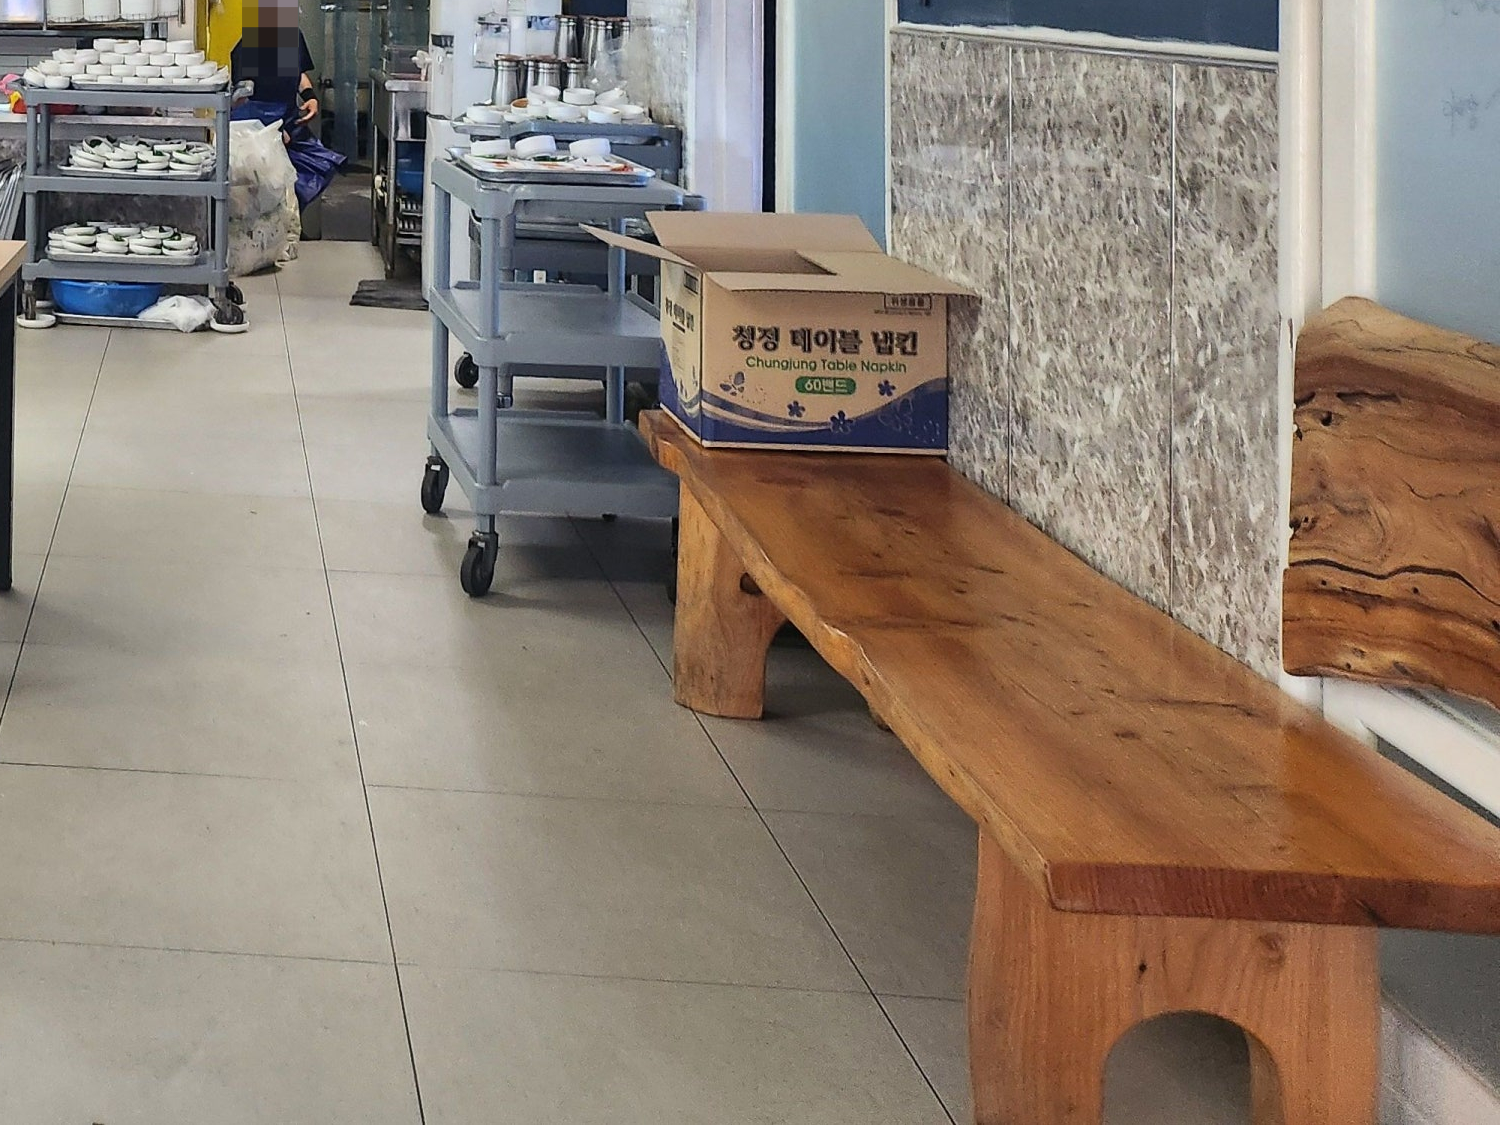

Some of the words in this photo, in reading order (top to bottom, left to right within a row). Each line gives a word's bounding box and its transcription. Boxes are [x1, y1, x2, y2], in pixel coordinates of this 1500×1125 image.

[733, 325, 780, 352] 청정
[789, 327, 862, 355] 테이블
[871, 329, 919, 356] 냅킨
[746, 356, 817, 371] Chungjung
[822, 359, 857, 372] Table
[861, 361, 907, 373] Napkin
